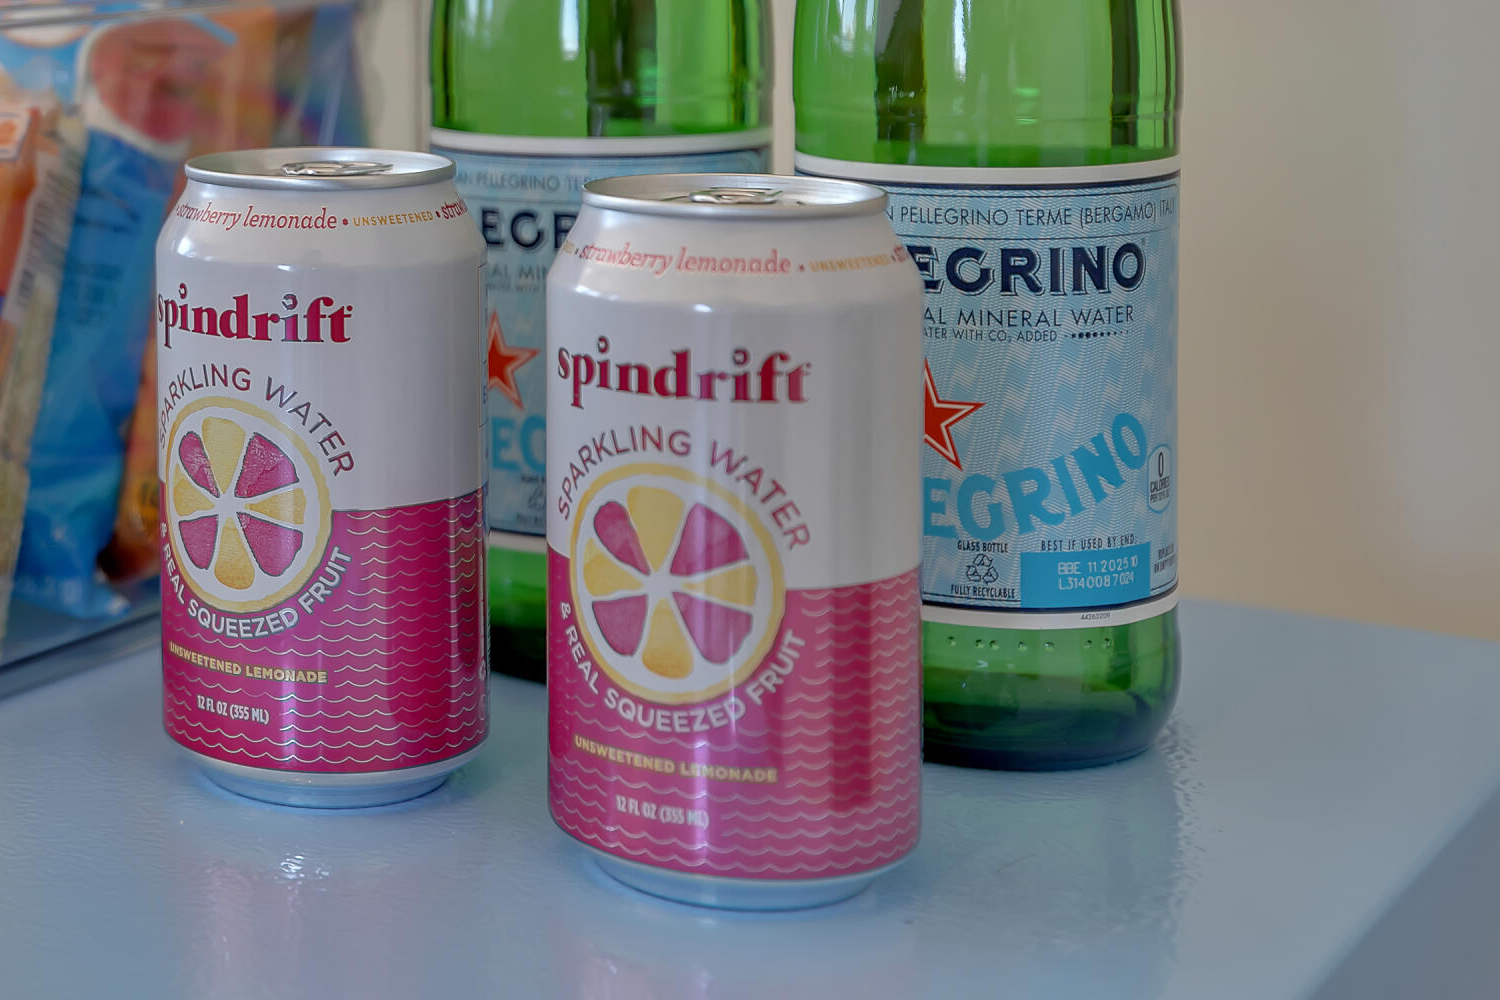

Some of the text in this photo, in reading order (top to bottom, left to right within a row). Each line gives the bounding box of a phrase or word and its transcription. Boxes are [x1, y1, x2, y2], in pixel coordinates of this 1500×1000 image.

[242, 206, 337, 230] lemonade
[353, 210, 435, 228] UNSWEETENED
[900, 205, 1009, 226] PELLEGRINO
[1016, 208, 1073, 227] TERME
[1080, 201, 1157, 229] (BERGAMO)
[579, 241, 674, 279] strawberry
[676, 246, 792, 275] lemonade
[157, 282, 354, 349] spindrift
[957, 309, 1062, 328] MINERAL
[1070, 305, 1134, 325] WATER
[952, 328, 988, 341] WITH
[1017, 330, 1057, 342] ADDED
[557, 336, 813, 410] spindrift
[158, 363, 355, 477] SPARKLING WATER
[558, 425, 811, 551] SPARKLING WATER
[957, 540, 1009, 553] GLASS BOTTLE
[1041, 540, 1063, 551] BEST
[1068, 540, 1077, 550] IF
[1081, 537, 1103, 550] USED
[1107, 536, 1117, 548] BY
[163, 543, 186, 605] REAL
[187, 598, 300, 640] SQUEEZED
[298, 546, 352, 615] FRUIT
[950, 584, 1016, 599] FULLY RECYCLABLE
[169, 641, 329, 684] UNSWEETENED LEMONADE
[560, 601, 806, 733] & REAL SQUEEZED FRUIT
[197, 695, 270, 725] 12 FL OZ (355 ML)
[573, 734, 779, 785] UNSWEETENED LEMONADE
[616, 795, 627, 811] 12
[628, 797, 640, 814] FL
[641, 799, 657, 820] OZ
[659, 801, 686, 825] (355
